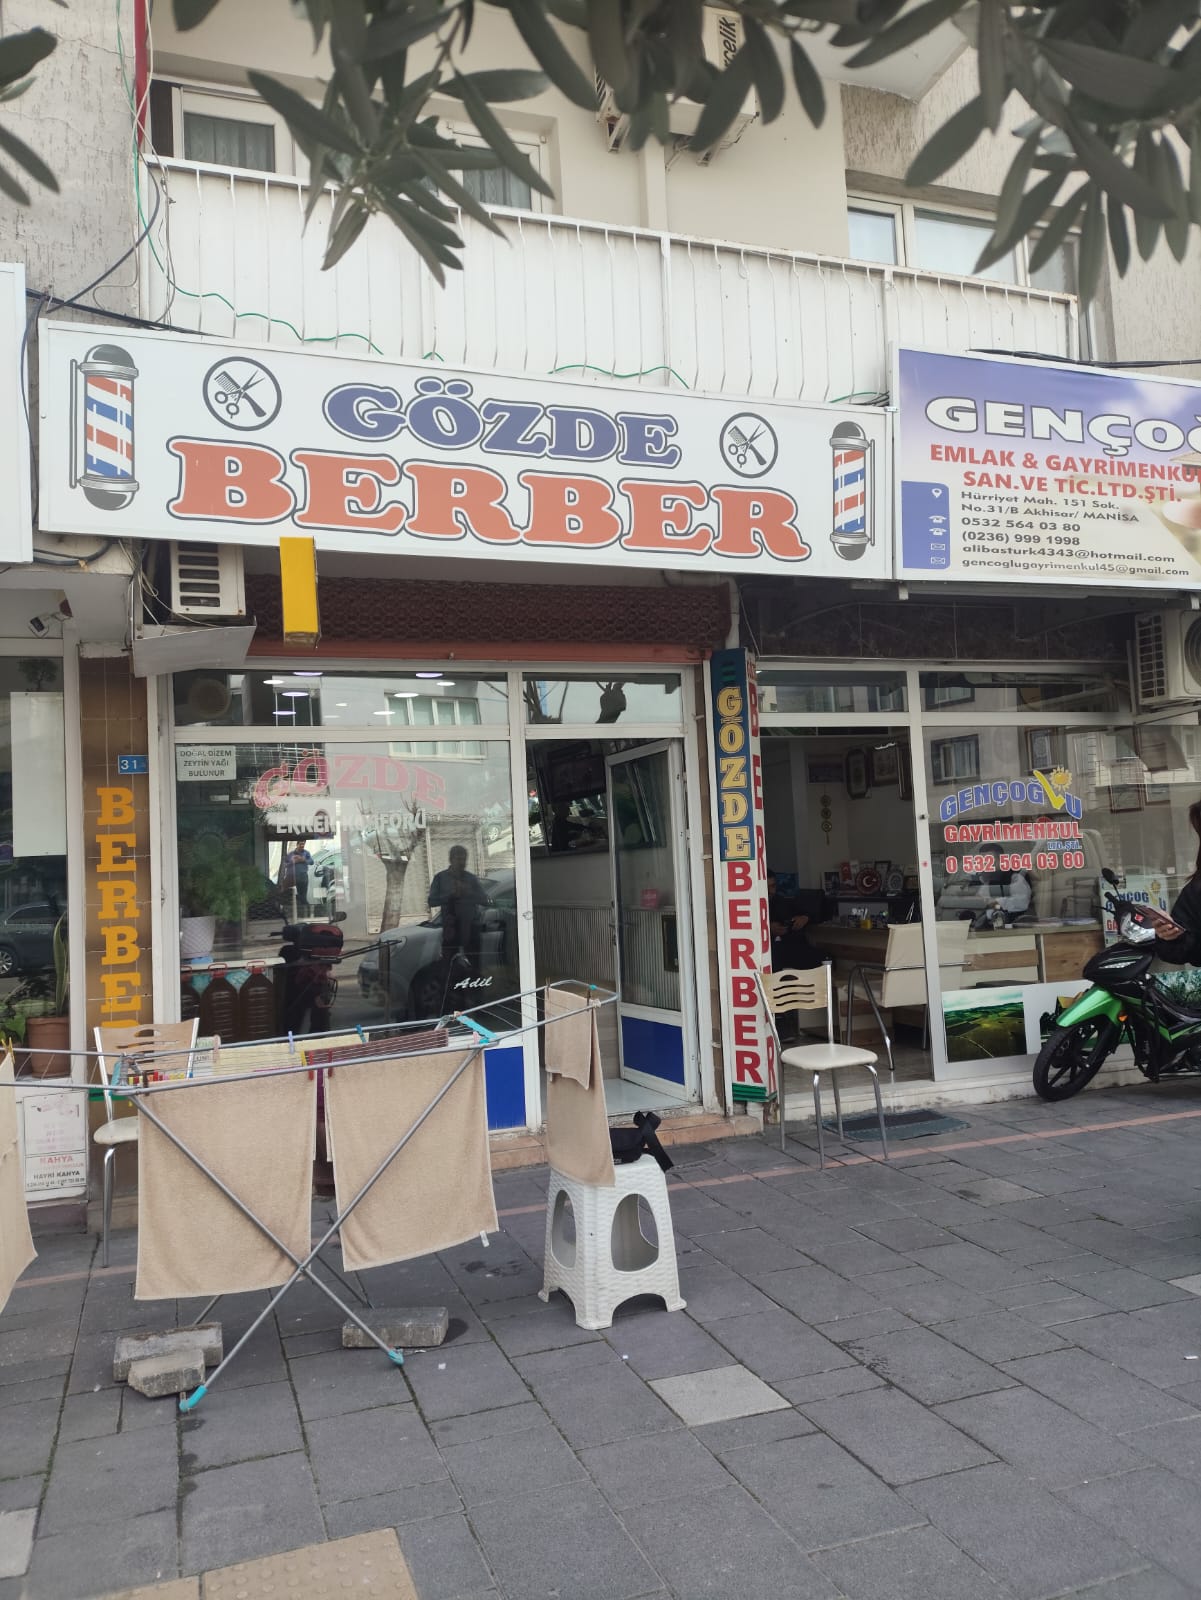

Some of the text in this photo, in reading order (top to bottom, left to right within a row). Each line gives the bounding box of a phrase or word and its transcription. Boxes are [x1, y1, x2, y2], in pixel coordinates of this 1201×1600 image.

[323, 376, 681, 468] GÖZDE
[925, 396, 1201, 457] GENÇO
[930, 444, 1016, 468] EMLAK
[1022, 453, 1038, 470] &
[963, 471, 1048, 492] SAN.VE
[166, 436, 811, 562] BERBER
[961, 491, 1120, 510] Hürriyet Mah. 151 Sok.
[961, 503, 1019, 515] No.31/B
[1083, 511, 1139, 522] MANİSA
[961, 517, 1081, 532] 0532 564 03 80
[962, 531, 1080, 546] (0236) 999 1998
[962, 545, 1175, 563] alibasturk4343@hotmail.com
[962, 560, 1189, 576] gencoglugayrimenkul45@gmail.com
[120, 759, 137, 770] 31
[188, 769, 225, 777] BULUNUR
[944, 821, 1083, 843] GAYRİMENKUL
[945, 851, 1084, 873] 0 532 564 03 80
[748, 682, 776, 1094] BERBR
[96, 787, 141, 1028] BERBE
[727, 861, 763, 1083] BERBER
[454, 976, 493, 990] Adil
